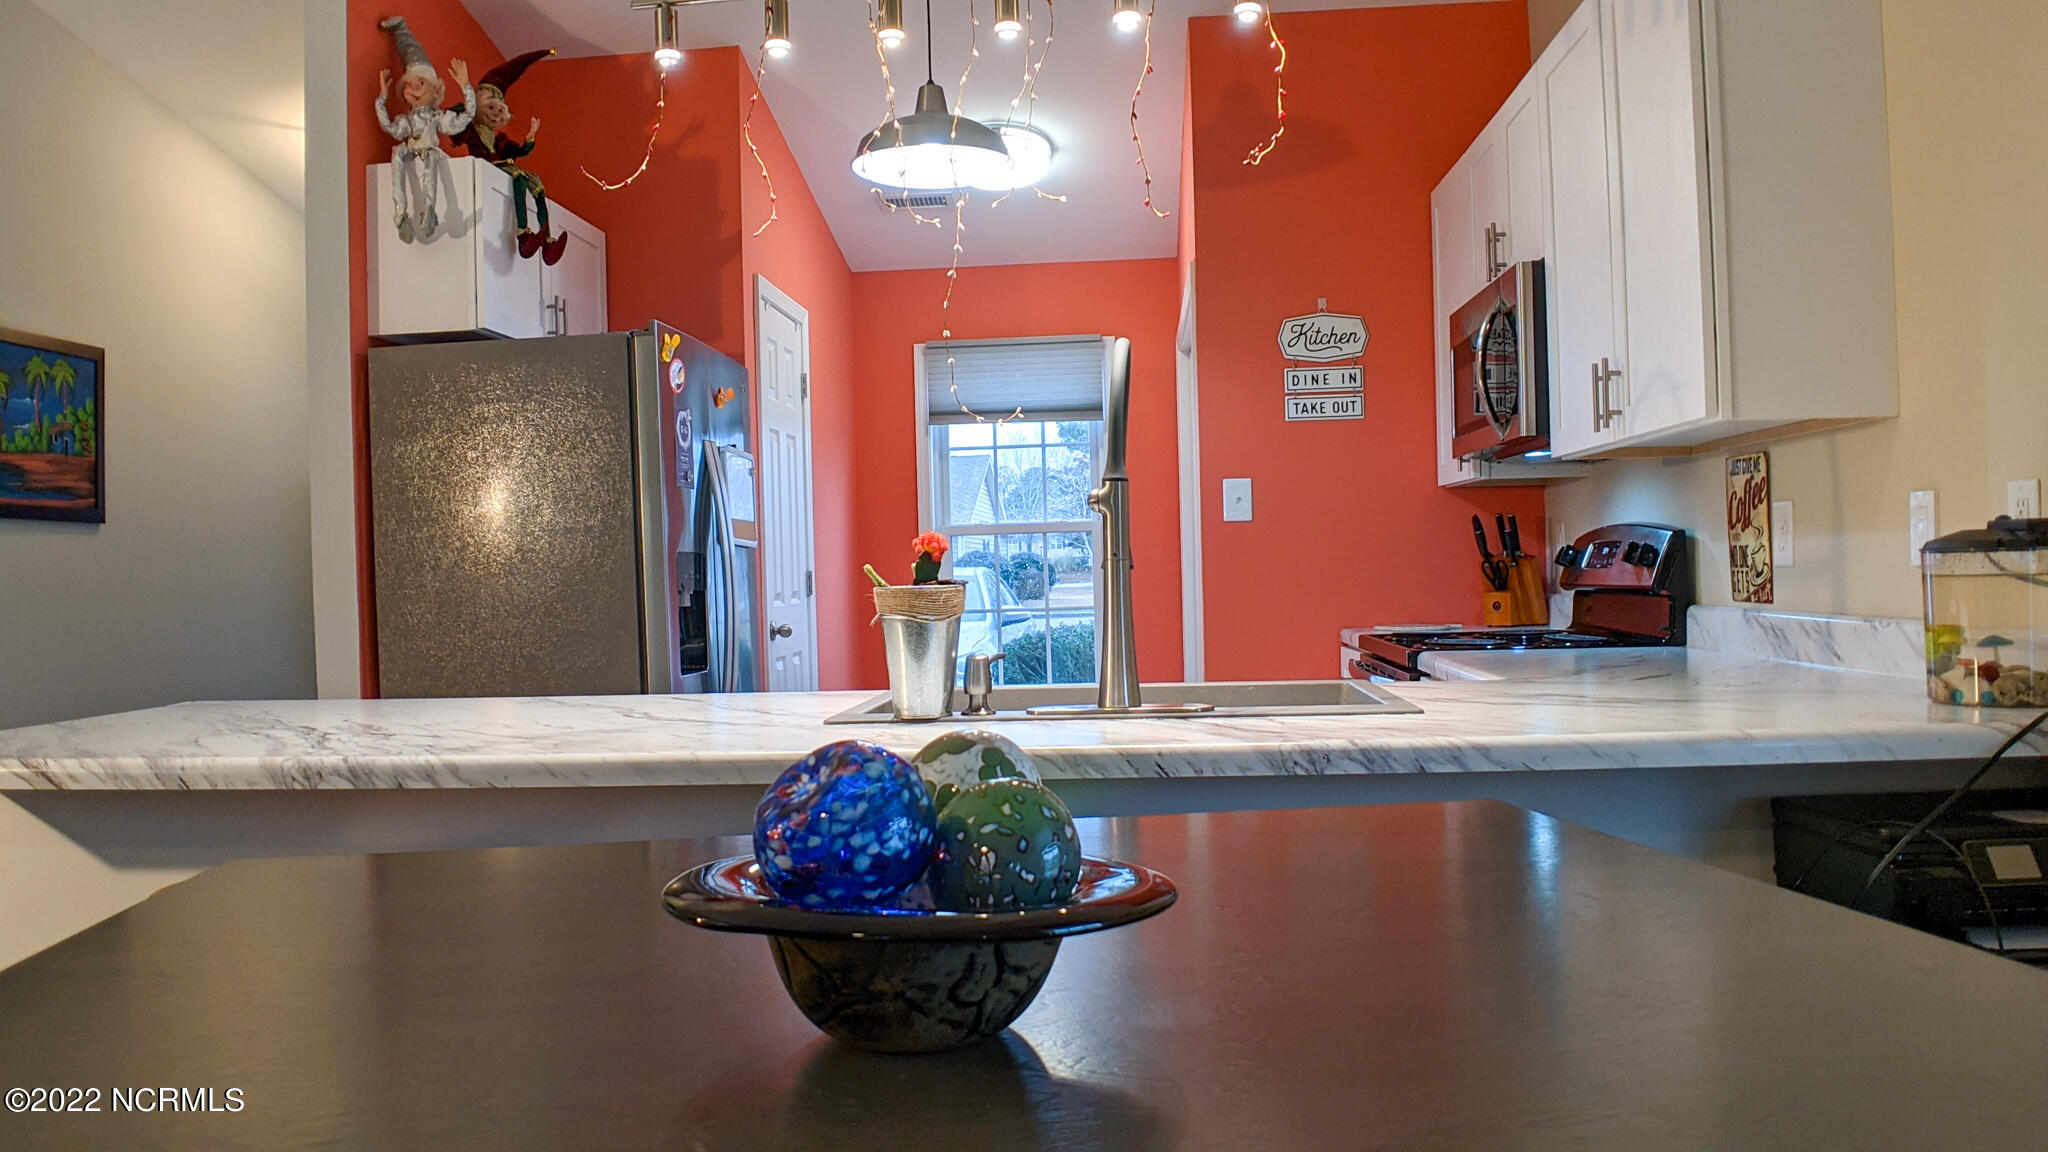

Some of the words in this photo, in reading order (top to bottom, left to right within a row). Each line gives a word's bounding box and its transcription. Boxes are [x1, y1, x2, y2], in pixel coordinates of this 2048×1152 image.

[1287, 321, 1361, 352] Kitchen
[1291, 373, 1330, 387] DINE
[1341, 372, 1357, 385] IN
[1293, 401, 1327, 415] TAKE
[1332, 400, 1358, 414] OUT
[1753, 455, 1761, 473] ME
[1728, 474, 1767, 533] Coffee
